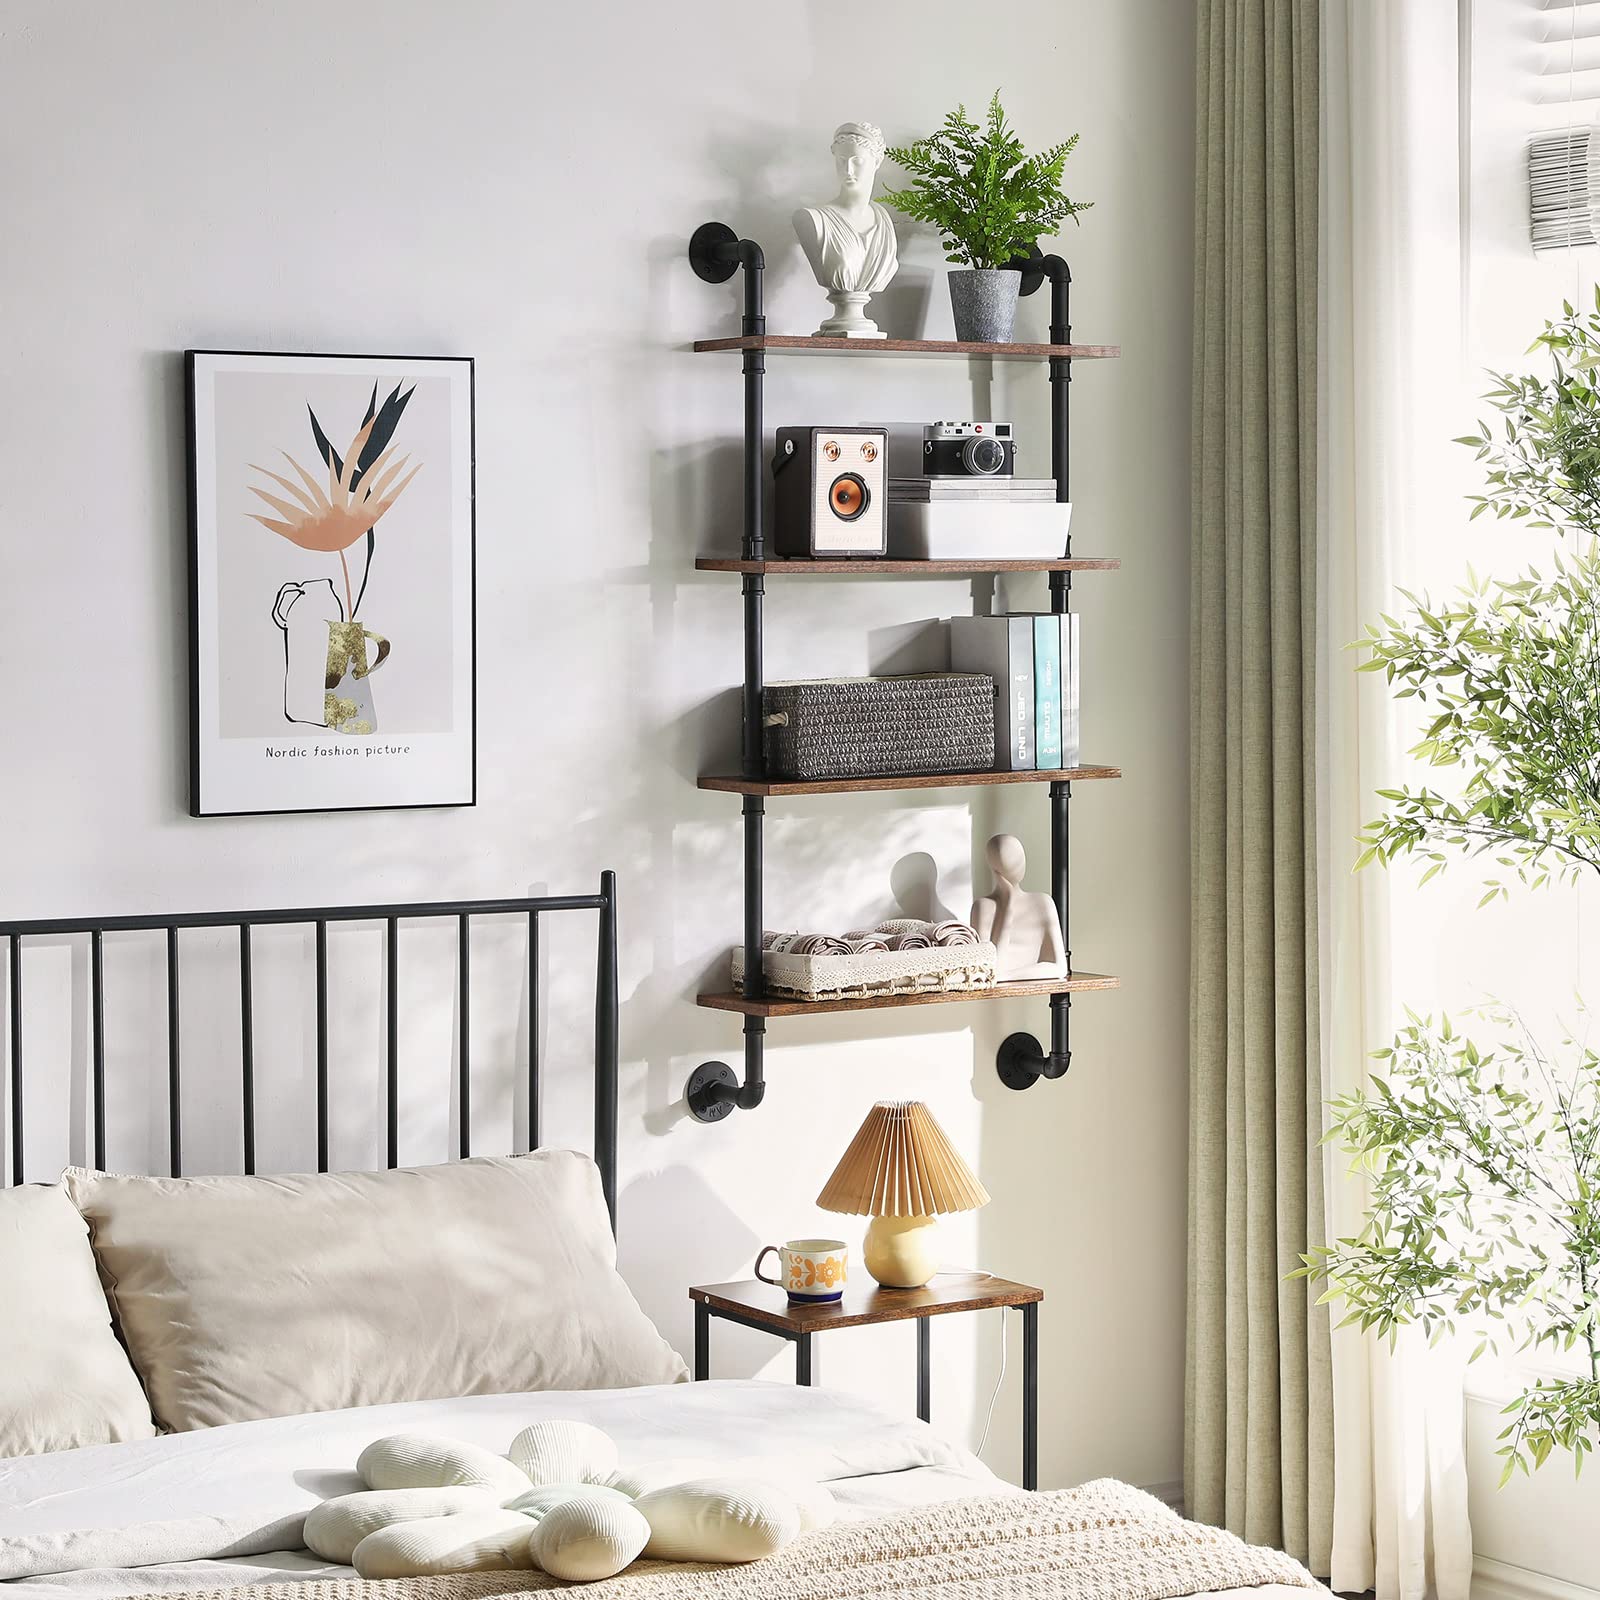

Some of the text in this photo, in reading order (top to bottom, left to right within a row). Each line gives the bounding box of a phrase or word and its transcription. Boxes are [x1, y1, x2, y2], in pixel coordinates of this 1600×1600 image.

[1017, 692, 1027, 760] JED LIND
[265, 744, 411, 758] Nordic fashion picture
